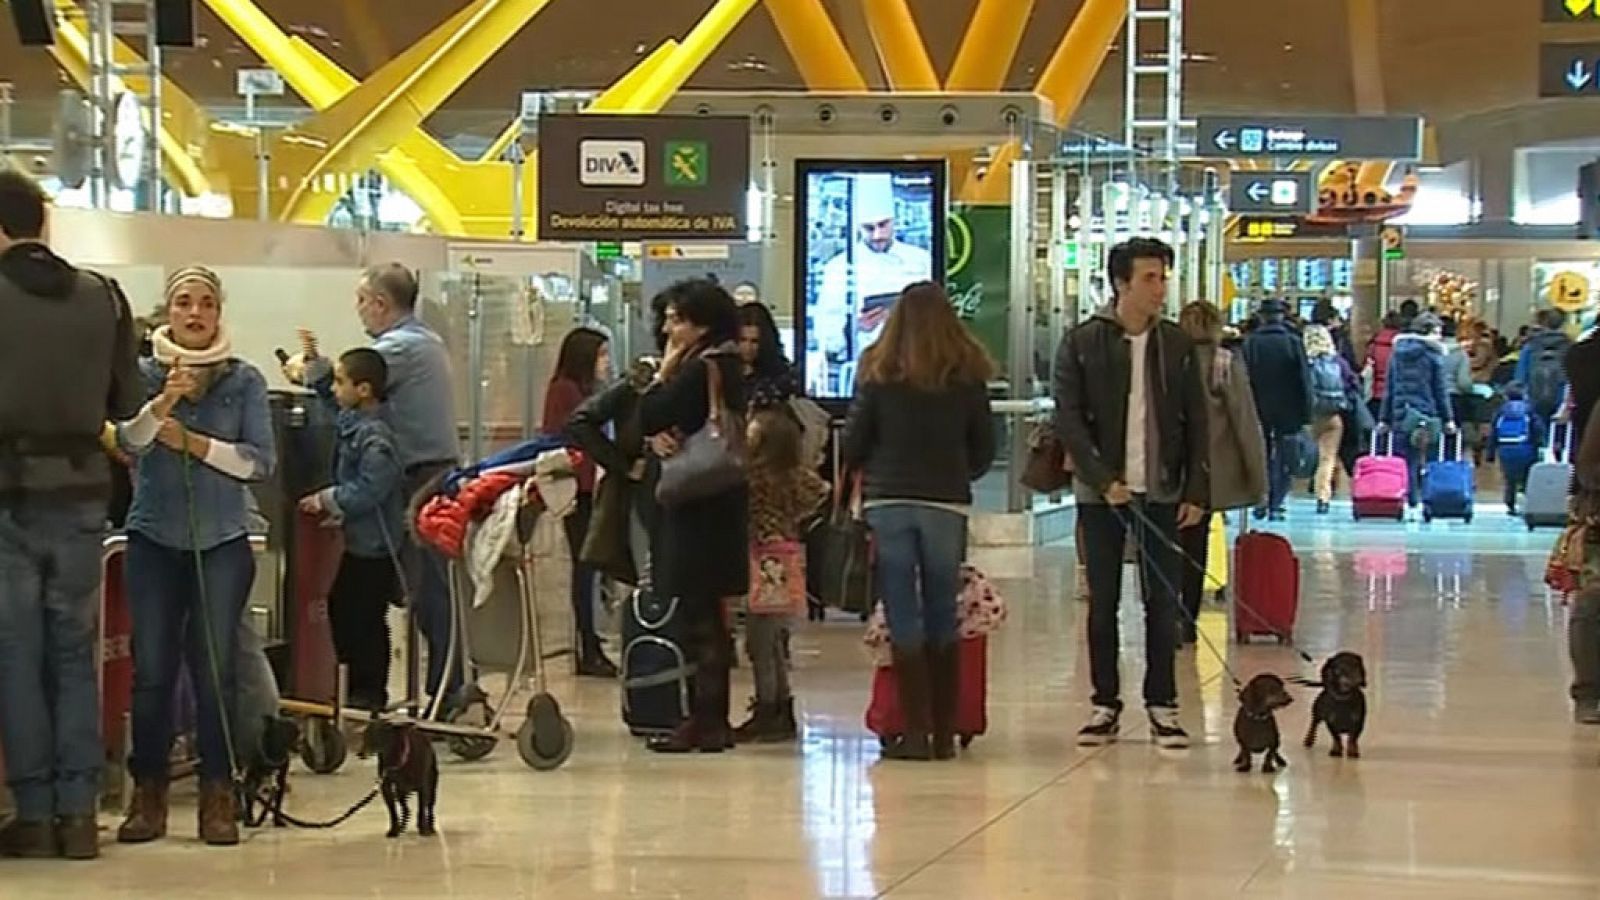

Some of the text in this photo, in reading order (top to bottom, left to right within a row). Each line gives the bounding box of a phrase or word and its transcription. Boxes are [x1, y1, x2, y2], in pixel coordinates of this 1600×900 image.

[605, 200, 641, 215] Digital
[550, 213, 737, 229] Devolución automática de IVA
